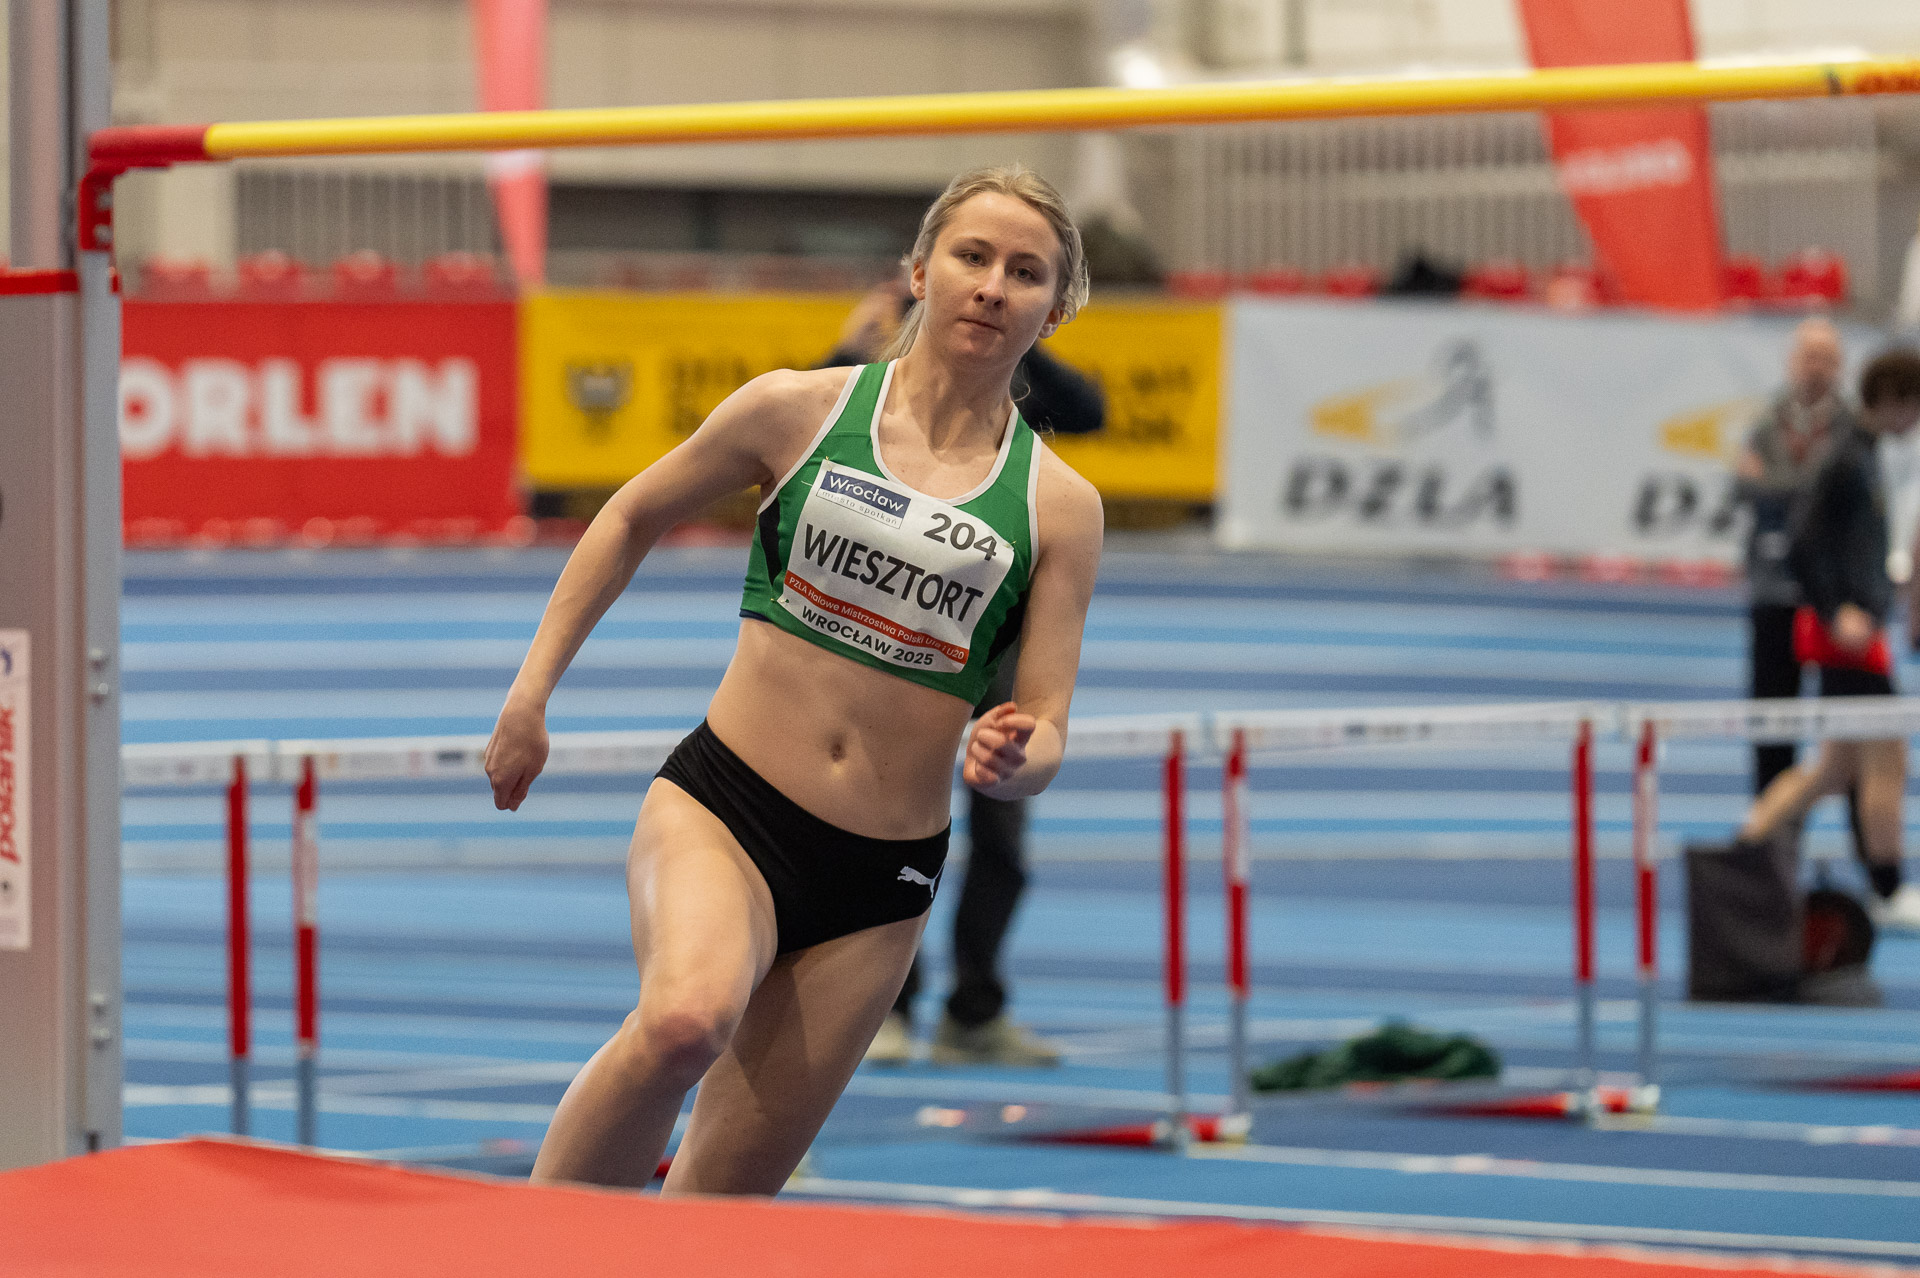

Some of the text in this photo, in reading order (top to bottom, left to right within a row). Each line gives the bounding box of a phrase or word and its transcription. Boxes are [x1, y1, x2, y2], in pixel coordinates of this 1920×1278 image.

[119, 356, 477, 459] ORLEN
[830, 475, 904, 512] Wrocław
[860, 505, 898, 526] spotkań
[923, 512, 997, 562] 204
[804, 523, 984, 622] WIESZTORT
[788, 576, 807, 594] PZLA
[808, 589, 840, 611] Halowe
[841, 606, 896, 635] Mistrzostwa
[897, 629, 924, 645] Polski
[946, 648, 965, 660] U20
[802, 605, 934, 666] WROCŁAW 2025
